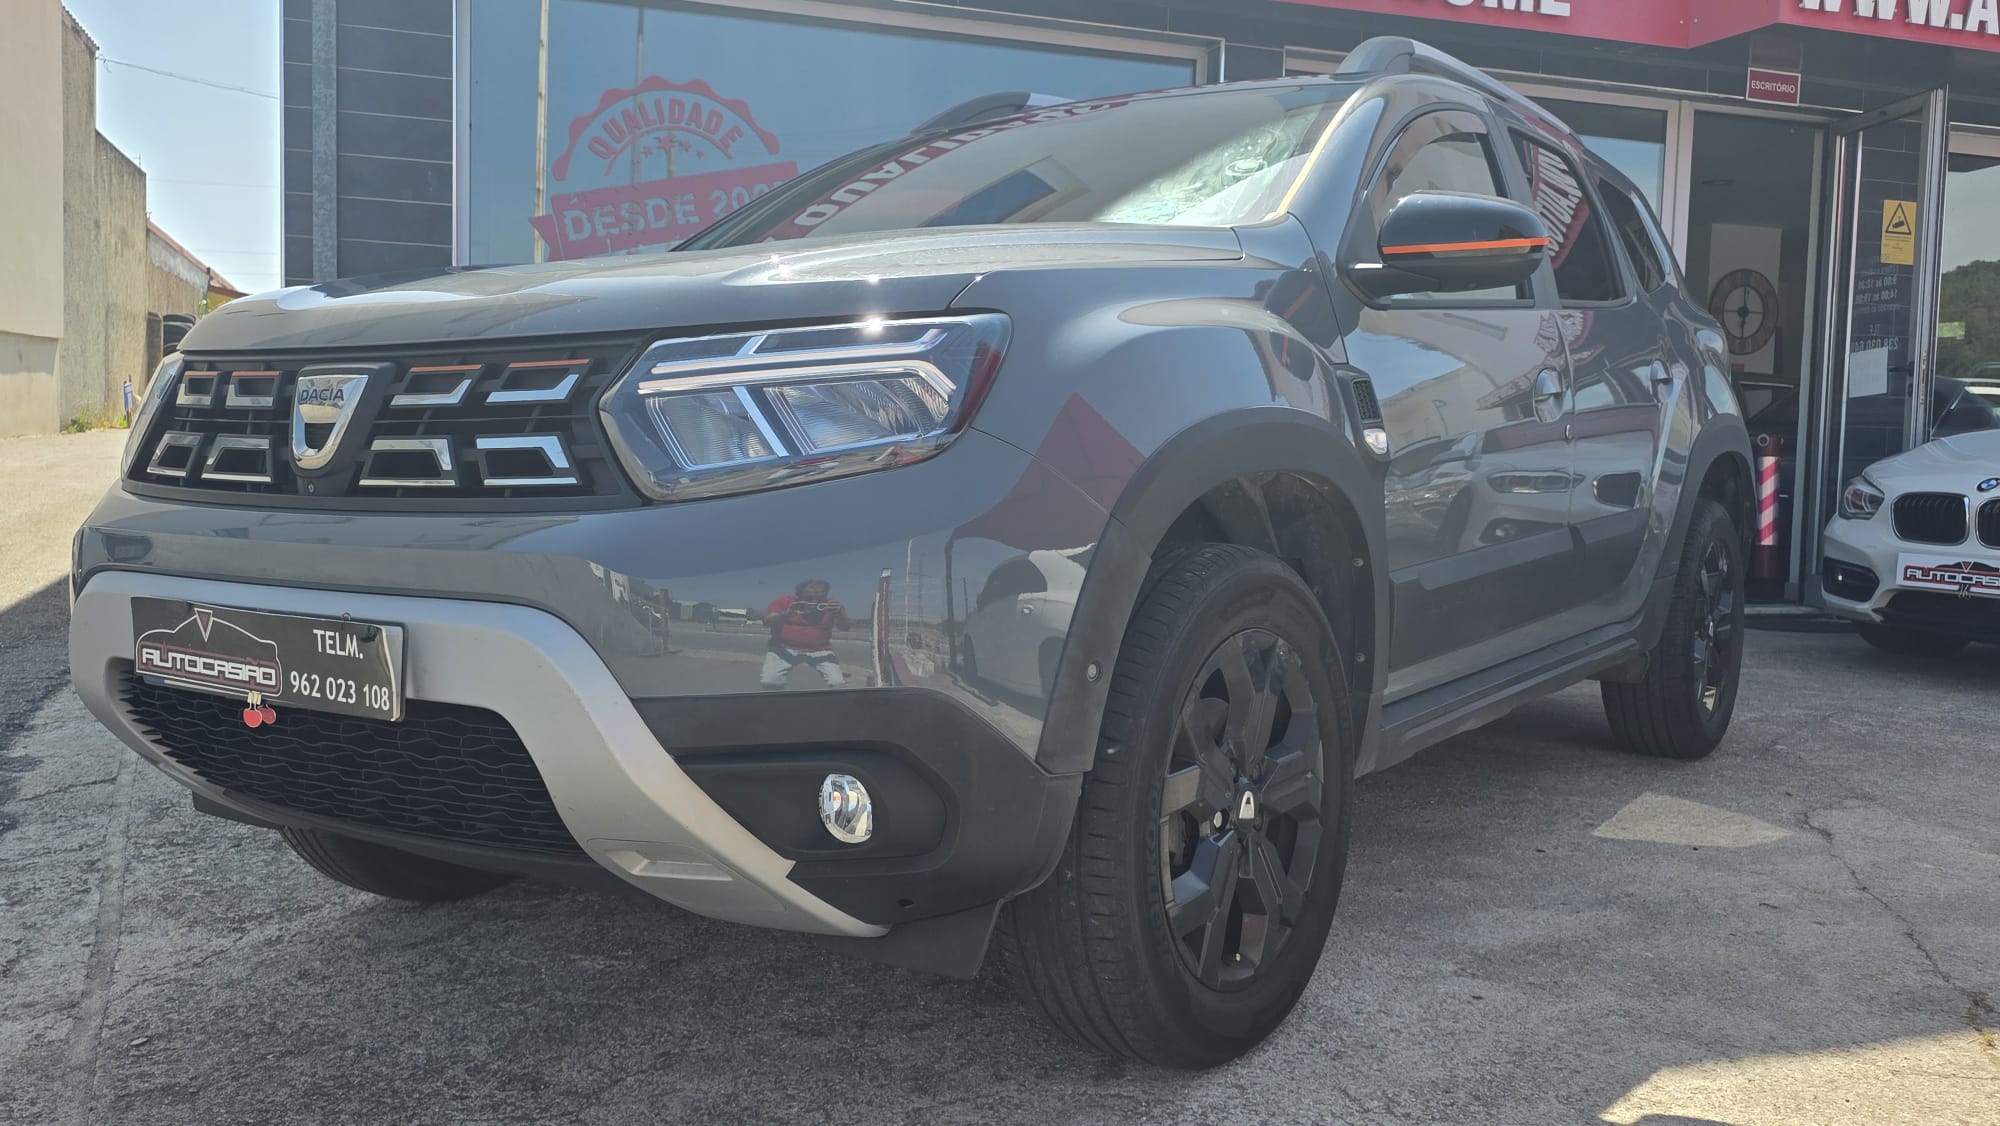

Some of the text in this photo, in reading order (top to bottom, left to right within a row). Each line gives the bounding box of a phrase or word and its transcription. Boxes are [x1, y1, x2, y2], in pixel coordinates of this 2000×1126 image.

[1751, 80, 1796, 94] ESCRITÓRIO
[588, 97, 745, 159] QUALIDADE
[563, 180, 784, 242] DESDE 200
[300, 388, 345, 402] DACIA
[313, 628, 364, 660] TELM.
[289, 671, 390, 711] 962 023 108
